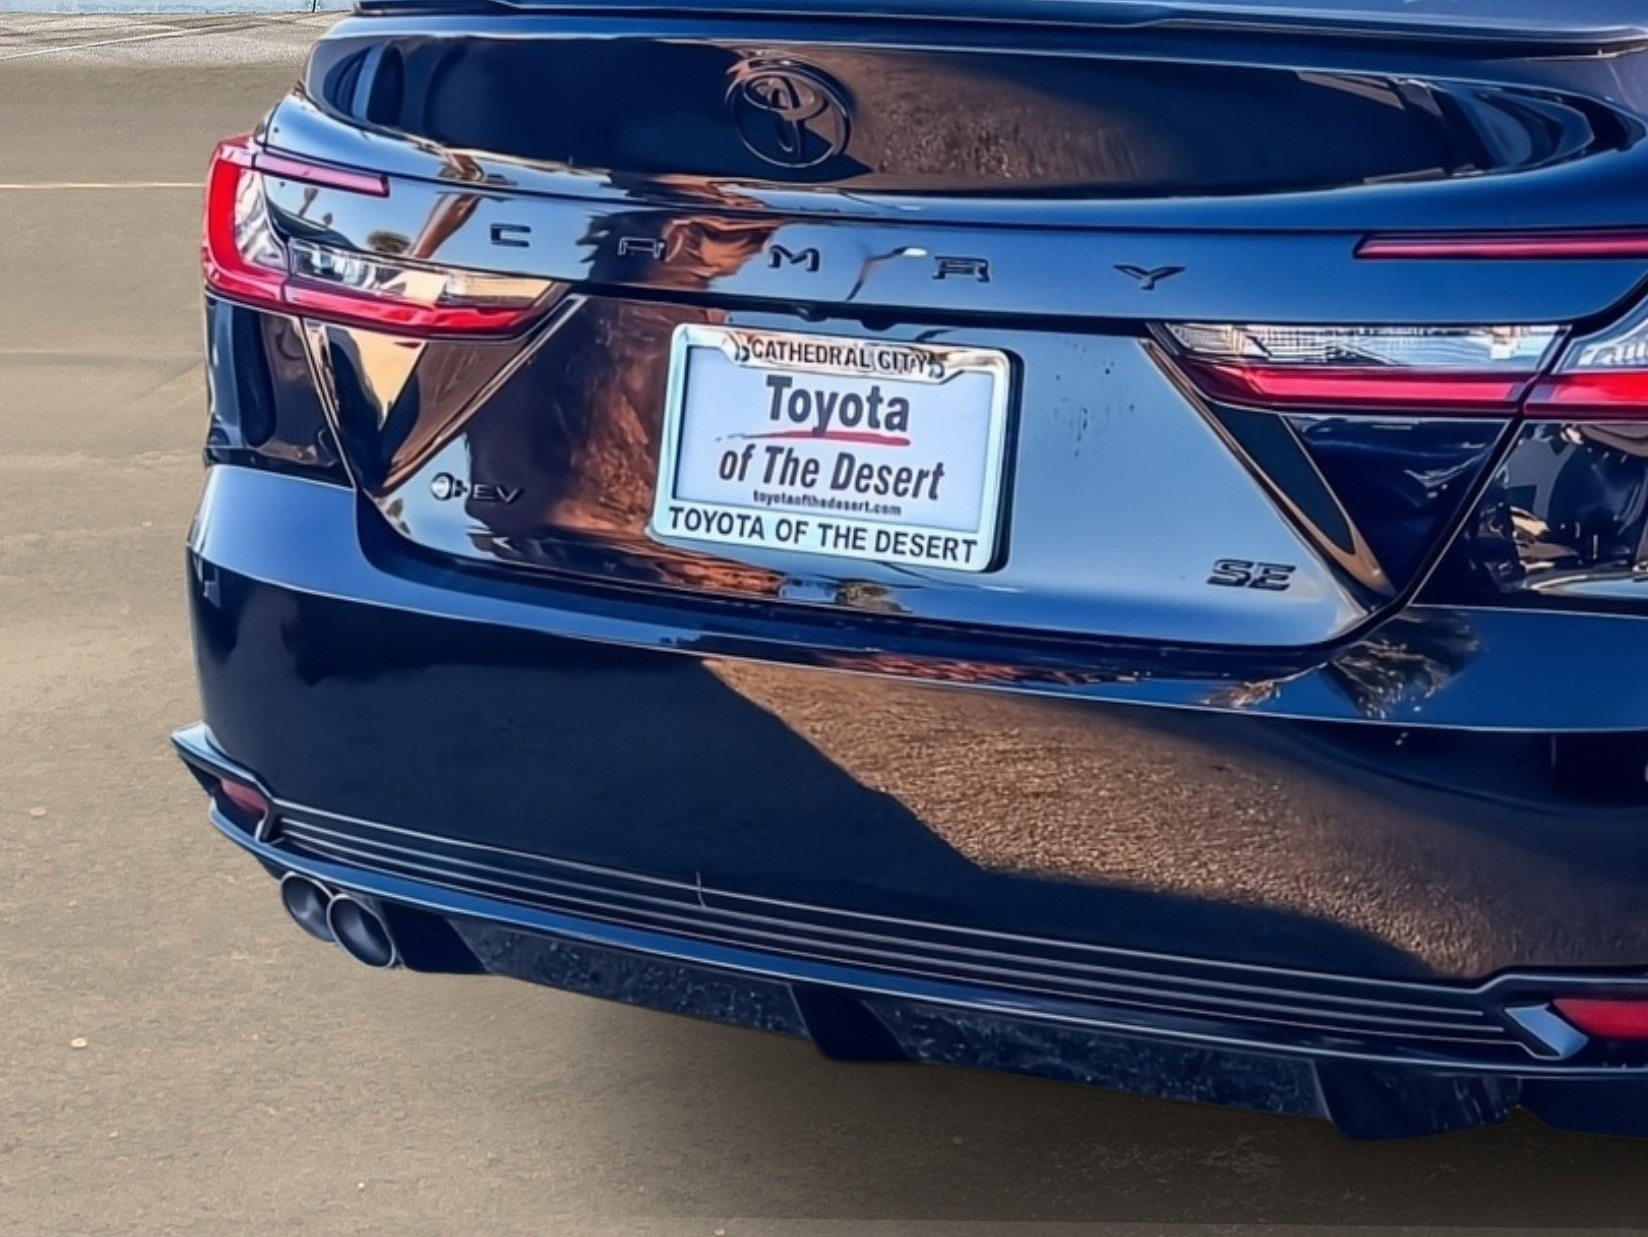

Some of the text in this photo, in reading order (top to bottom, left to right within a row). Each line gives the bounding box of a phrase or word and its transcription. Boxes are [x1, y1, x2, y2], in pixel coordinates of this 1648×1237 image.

[490, 222, 1187, 291] CAMRY
[752, 339, 928, 374] CATHEDRAL CITY
[766, 374, 911, 437] Toyota
[719, 443, 946, 500] of The Desert
[752, 489, 903, 516] toyotaofthedesert.com
[669, 505, 978, 564] TOYOTA OF THE DESERT
[1206, 559, 1297, 591] SE
